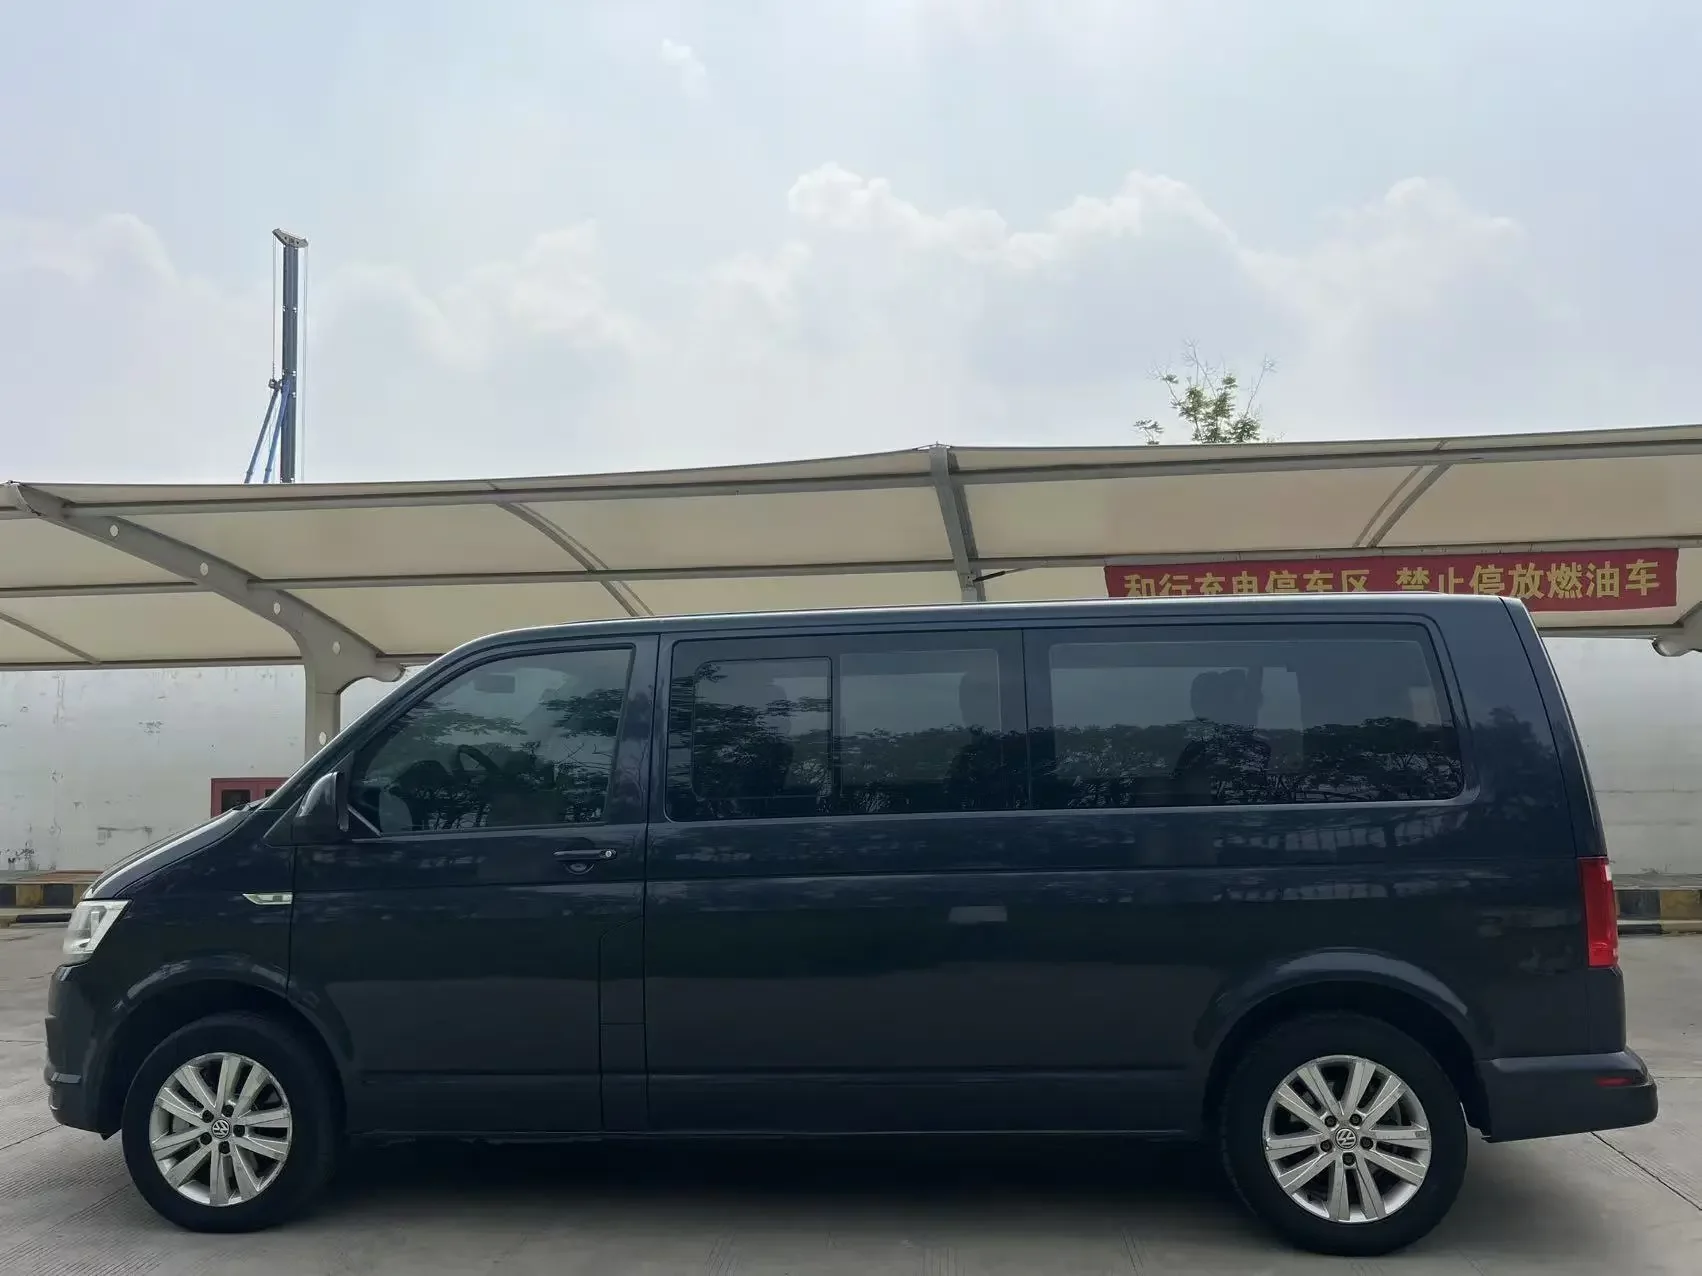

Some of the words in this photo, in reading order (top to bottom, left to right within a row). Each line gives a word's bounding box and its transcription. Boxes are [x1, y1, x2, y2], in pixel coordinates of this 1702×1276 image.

[1396, 558, 1661, 600] 禁止停放燃油车
